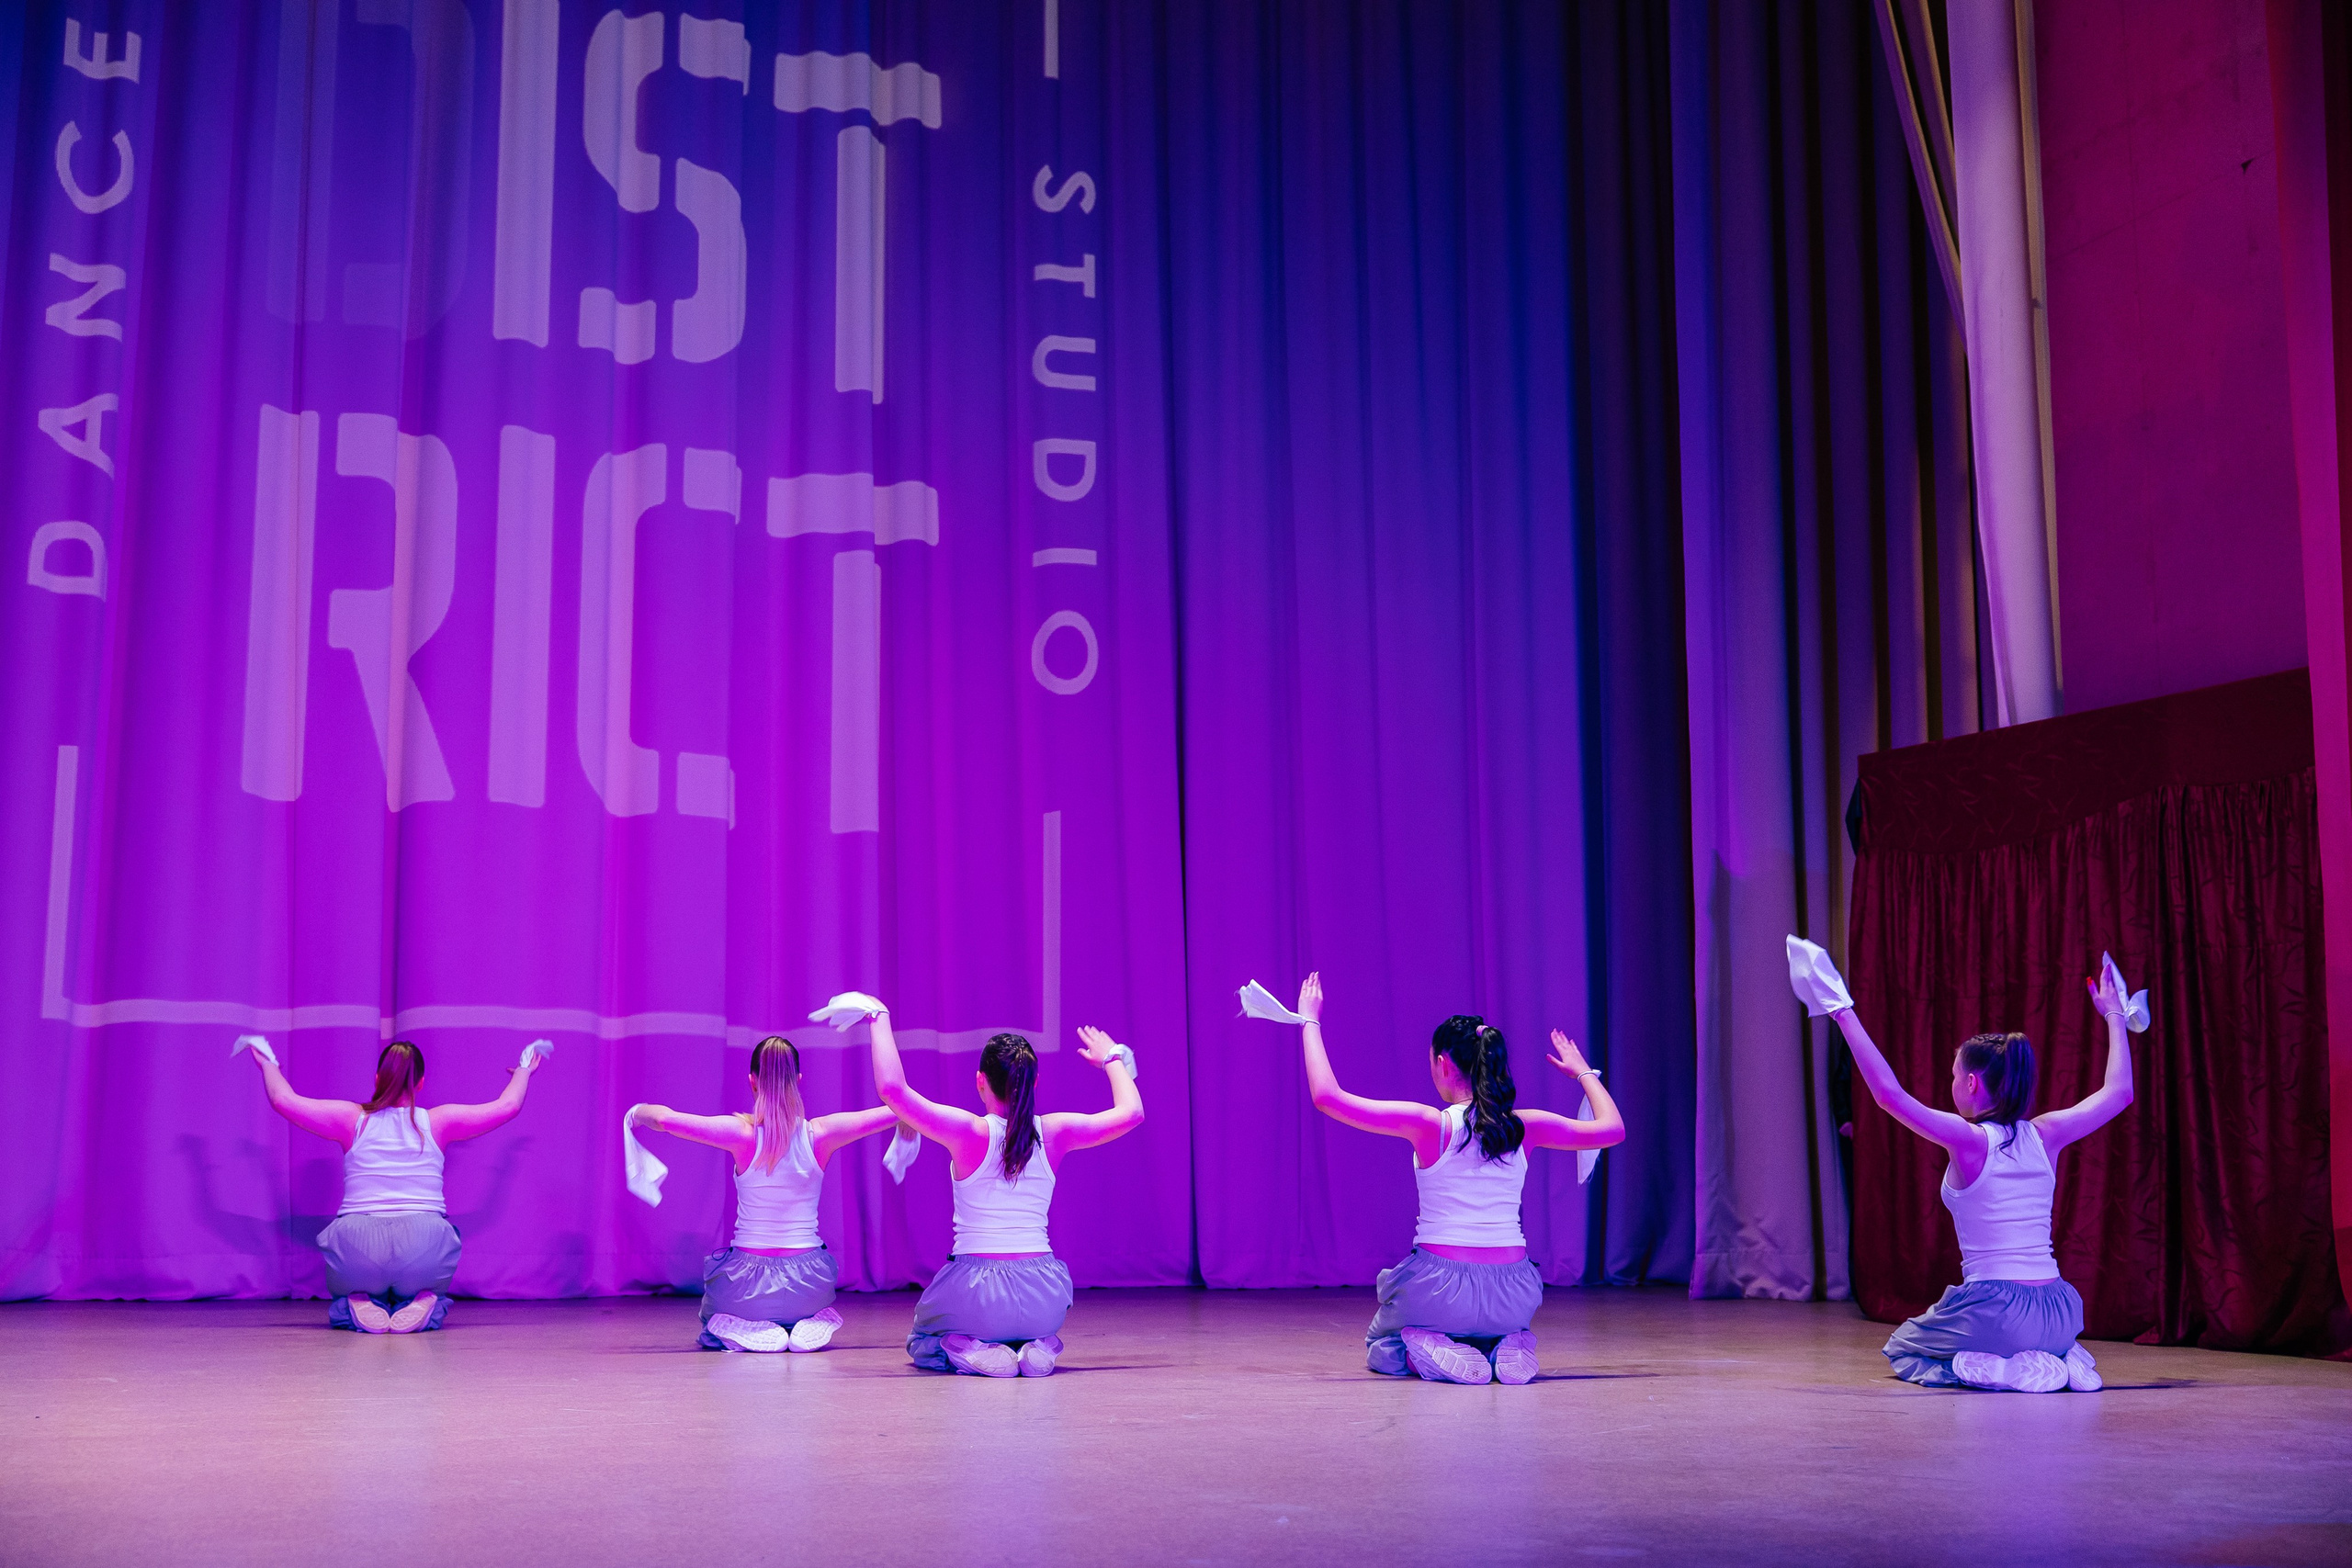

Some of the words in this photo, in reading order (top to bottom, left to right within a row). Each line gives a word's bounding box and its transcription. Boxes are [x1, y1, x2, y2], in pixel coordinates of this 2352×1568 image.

[27, 17, 142, 603] DANCE
[1031, 164, 1101, 696] STUDIO
[241, 402, 940, 834] RICT
